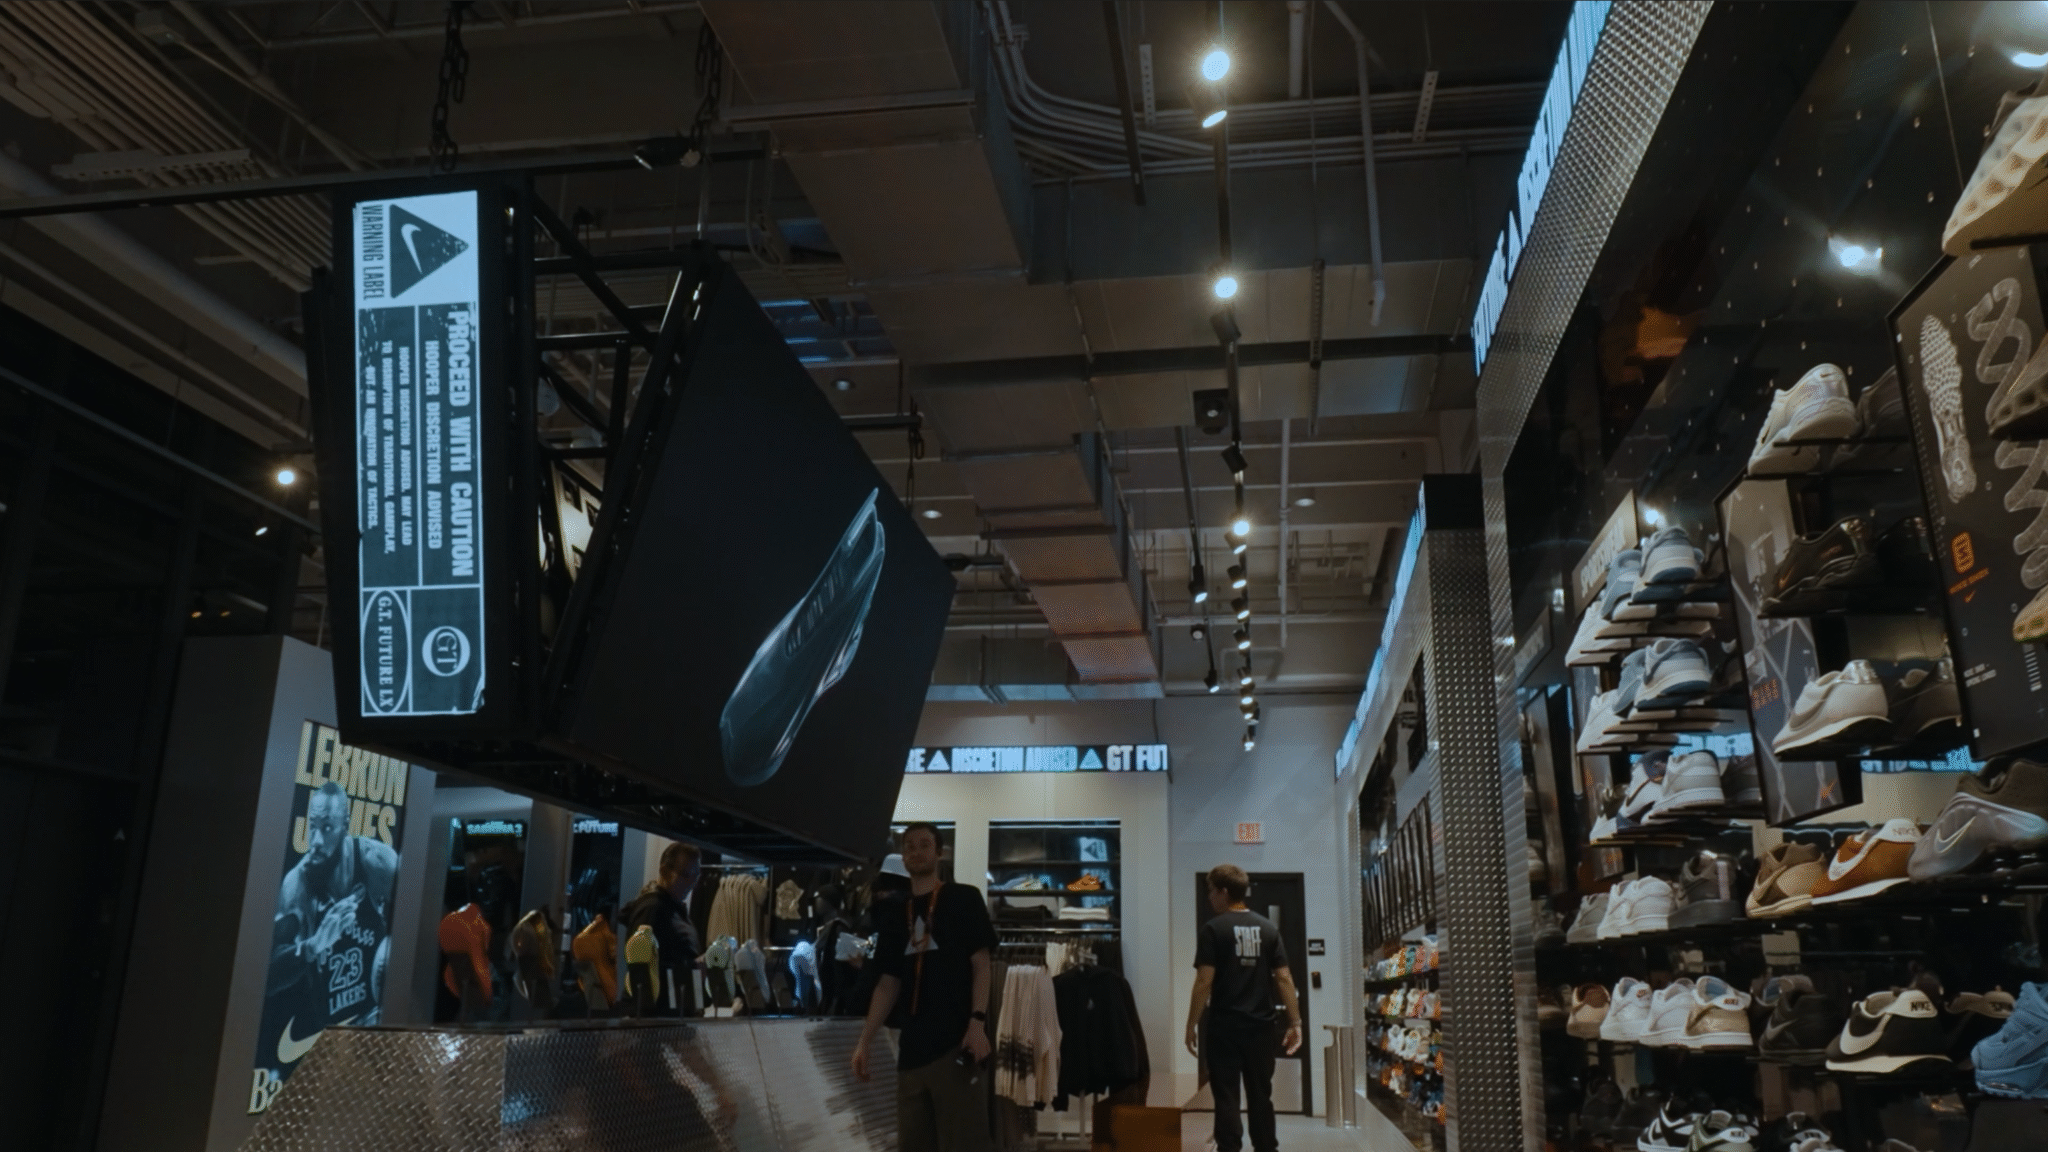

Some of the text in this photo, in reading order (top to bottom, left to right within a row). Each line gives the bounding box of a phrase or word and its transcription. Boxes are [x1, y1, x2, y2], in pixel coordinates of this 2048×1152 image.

[362, 204, 385, 300] WARNING LABEL
[382, 357, 393, 415] DISRUPTION
[399, 346, 410, 385] HOOPER
[366, 389, 377, 404] AN
[400, 388, 411, 446] DISCRETION
[383, 418, 394, 432] OF
[425, 340, 443, 549] HOOPER DISCRETION ADVISED
[447, 311, 474, 577] PROCEED WITH CAUTION
[367, 470, 378, 483] OF
[383, 435, 395, 498] TRADITIONAL
[401, 496, 412, 517] MAY
[401, 521, 413, 546] LEAD
[378, 596, 394, 707] G.T. FUTURE LX
[1107, 744, 1133, 772] GT
[292, 798, 397, 854] JMES
[1233, 925, 1262, 958] STAFF
[329, 947, 364, 993] 23
[329, 981, 367, 1016] LAKERS
